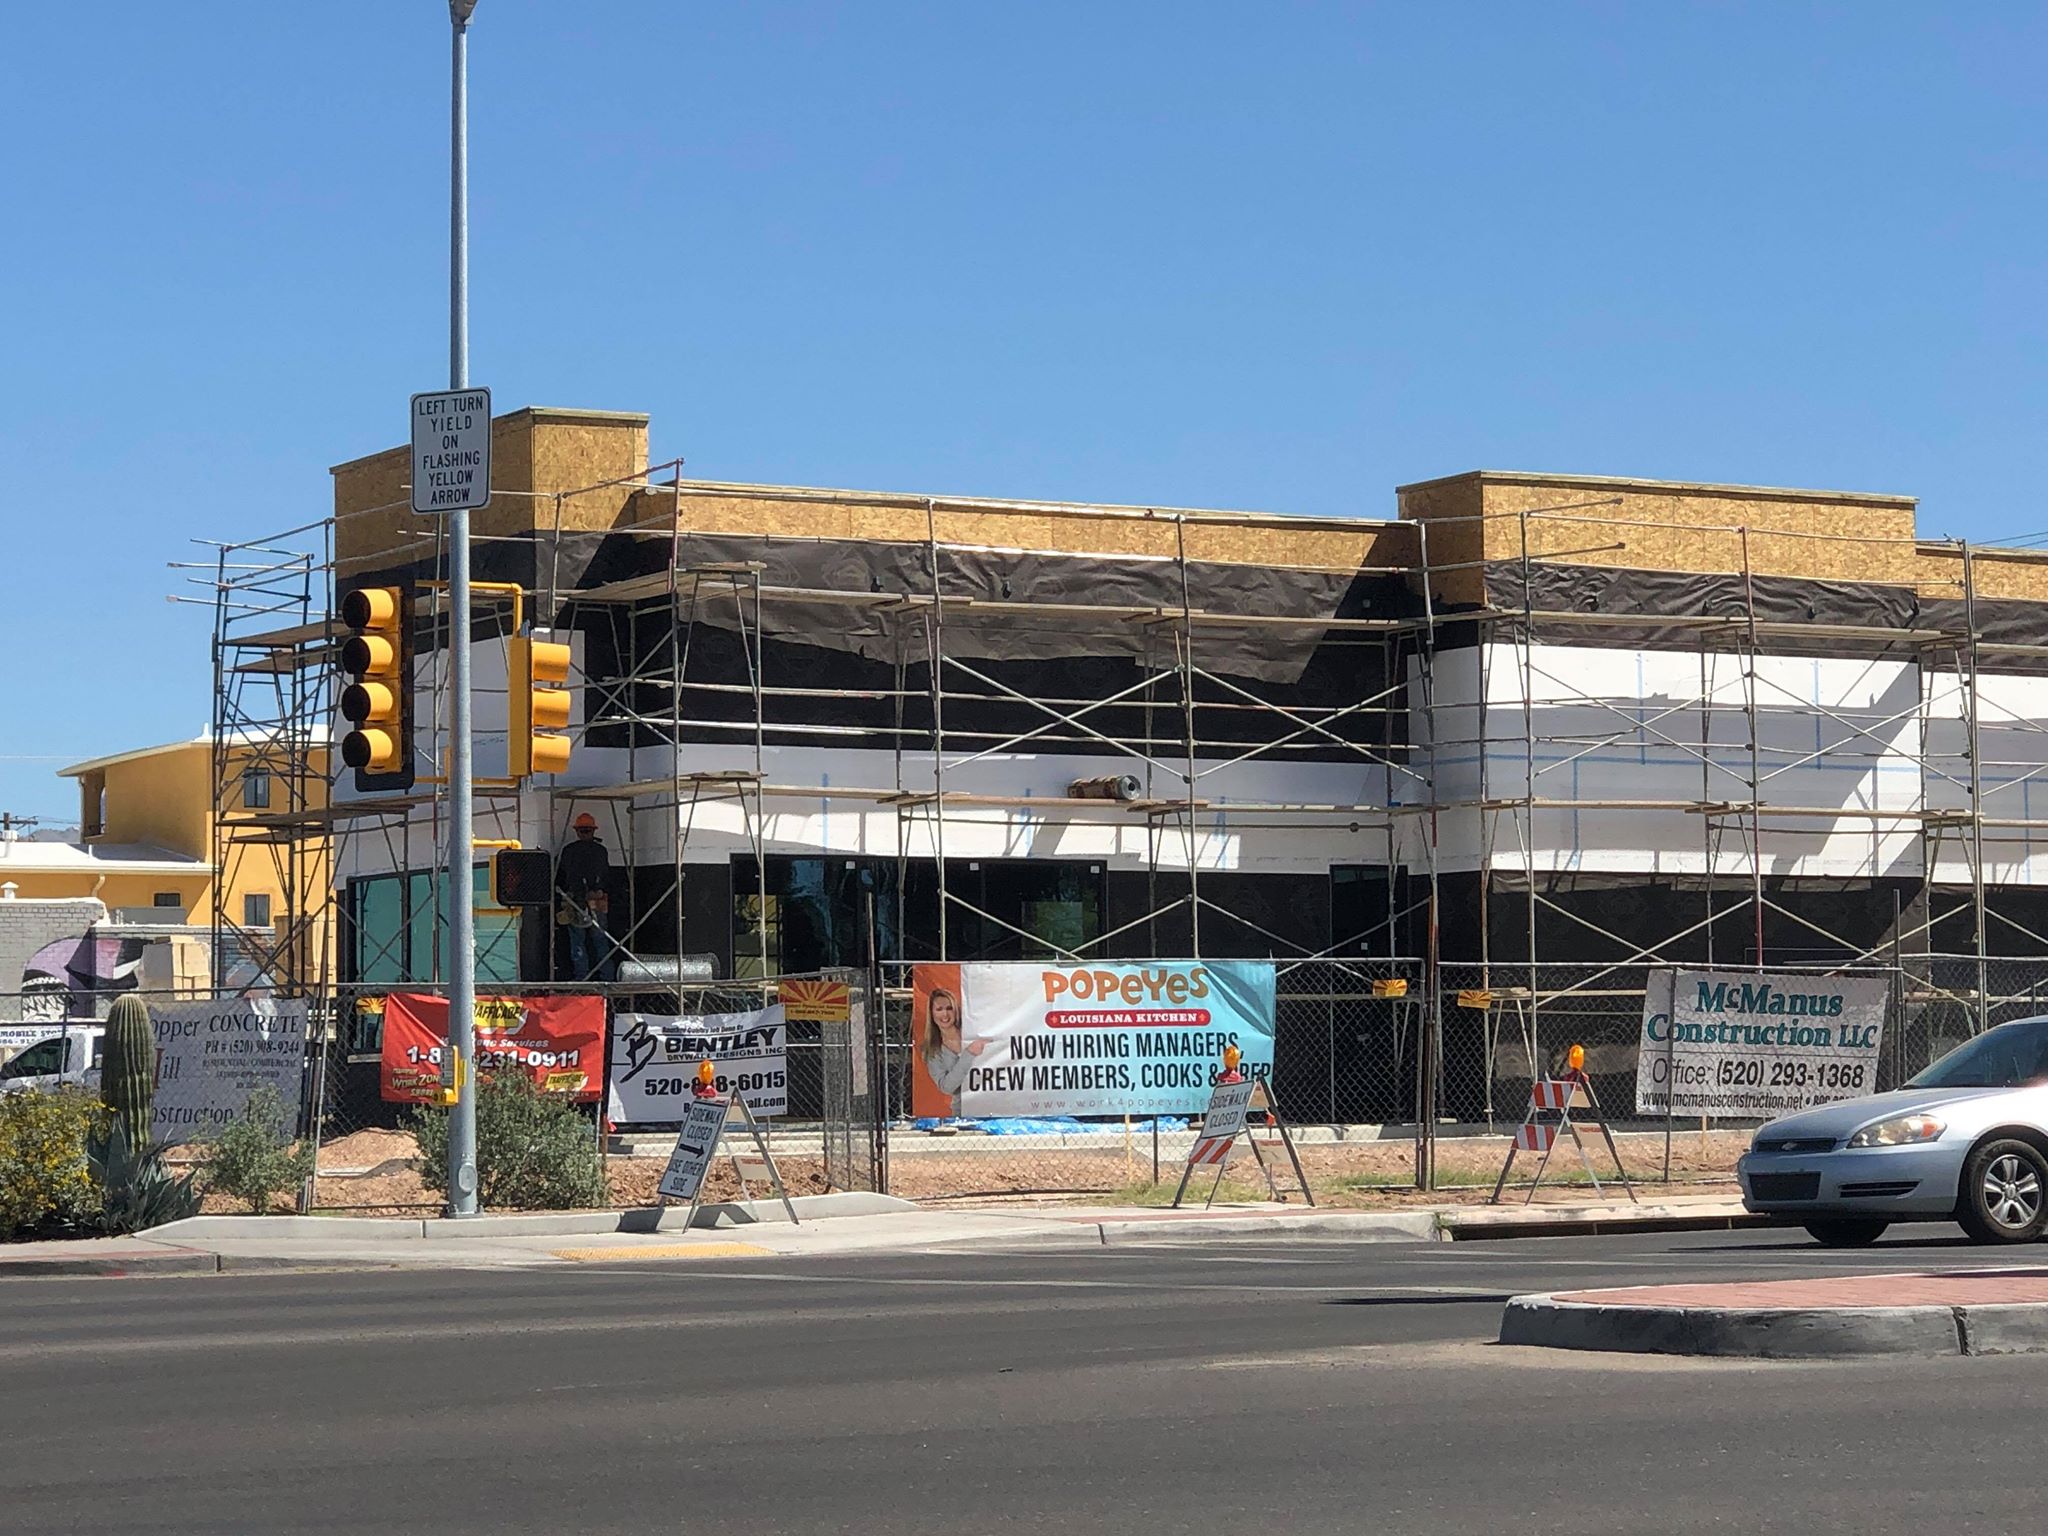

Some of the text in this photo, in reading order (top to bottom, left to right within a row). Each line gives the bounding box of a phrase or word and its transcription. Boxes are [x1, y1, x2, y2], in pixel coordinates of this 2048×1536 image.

[419, 396, 483, 415] LEFT TURN
[431, 416, 472, 432] YIELD
[442, 435, 458, 449] ON
[423, 451, 480, 470] FLASHING
[428, 470, 473, 487] YELLOW
[430, 488, 470, 505] ARROW
[1695, 981, 1843, 1016] McManus
[150, 1014, 299, 1042] opper CONCRETE
[1060, 1013, 1197, 1024] LOUISIANA KITCHEN
[1647, 1014, 1877, 1048] Construction LLC
[499, 1039, 549, 1047] Services
[665, 1028, 777, 1054] BENTLEY
[1010, 1032, 1244, 1060] NOW HIRING MANAGERS,
[406, 1045, 579, 1068] 1-8-231-0911
[667, 1046, 786, 1061] DRYWALL DESIGNS INC.
[418, 1074, 442, 1087] ZON
[969, 1065, 1025, 1092] CREW
[1032, 1064, 1136, 1092] MEMBERS,
[1142, 1063, 1200, 1089] COOKS
[1207, 1063, 1219, 1088] &
[1653, 1058, 1864, 1088] Ofice: (520) 293-1368
[1211, 1090, 1250, 1110] SIDEWALK
[1642, 1091, 1803, 1110] wwwmcmanusconstruction.net
[151, 1100, 234, 1123] nstruction
[1209, 1111, 1238, 1129] CLOSED
[687, 1125, 713, 1141] CLOSED
